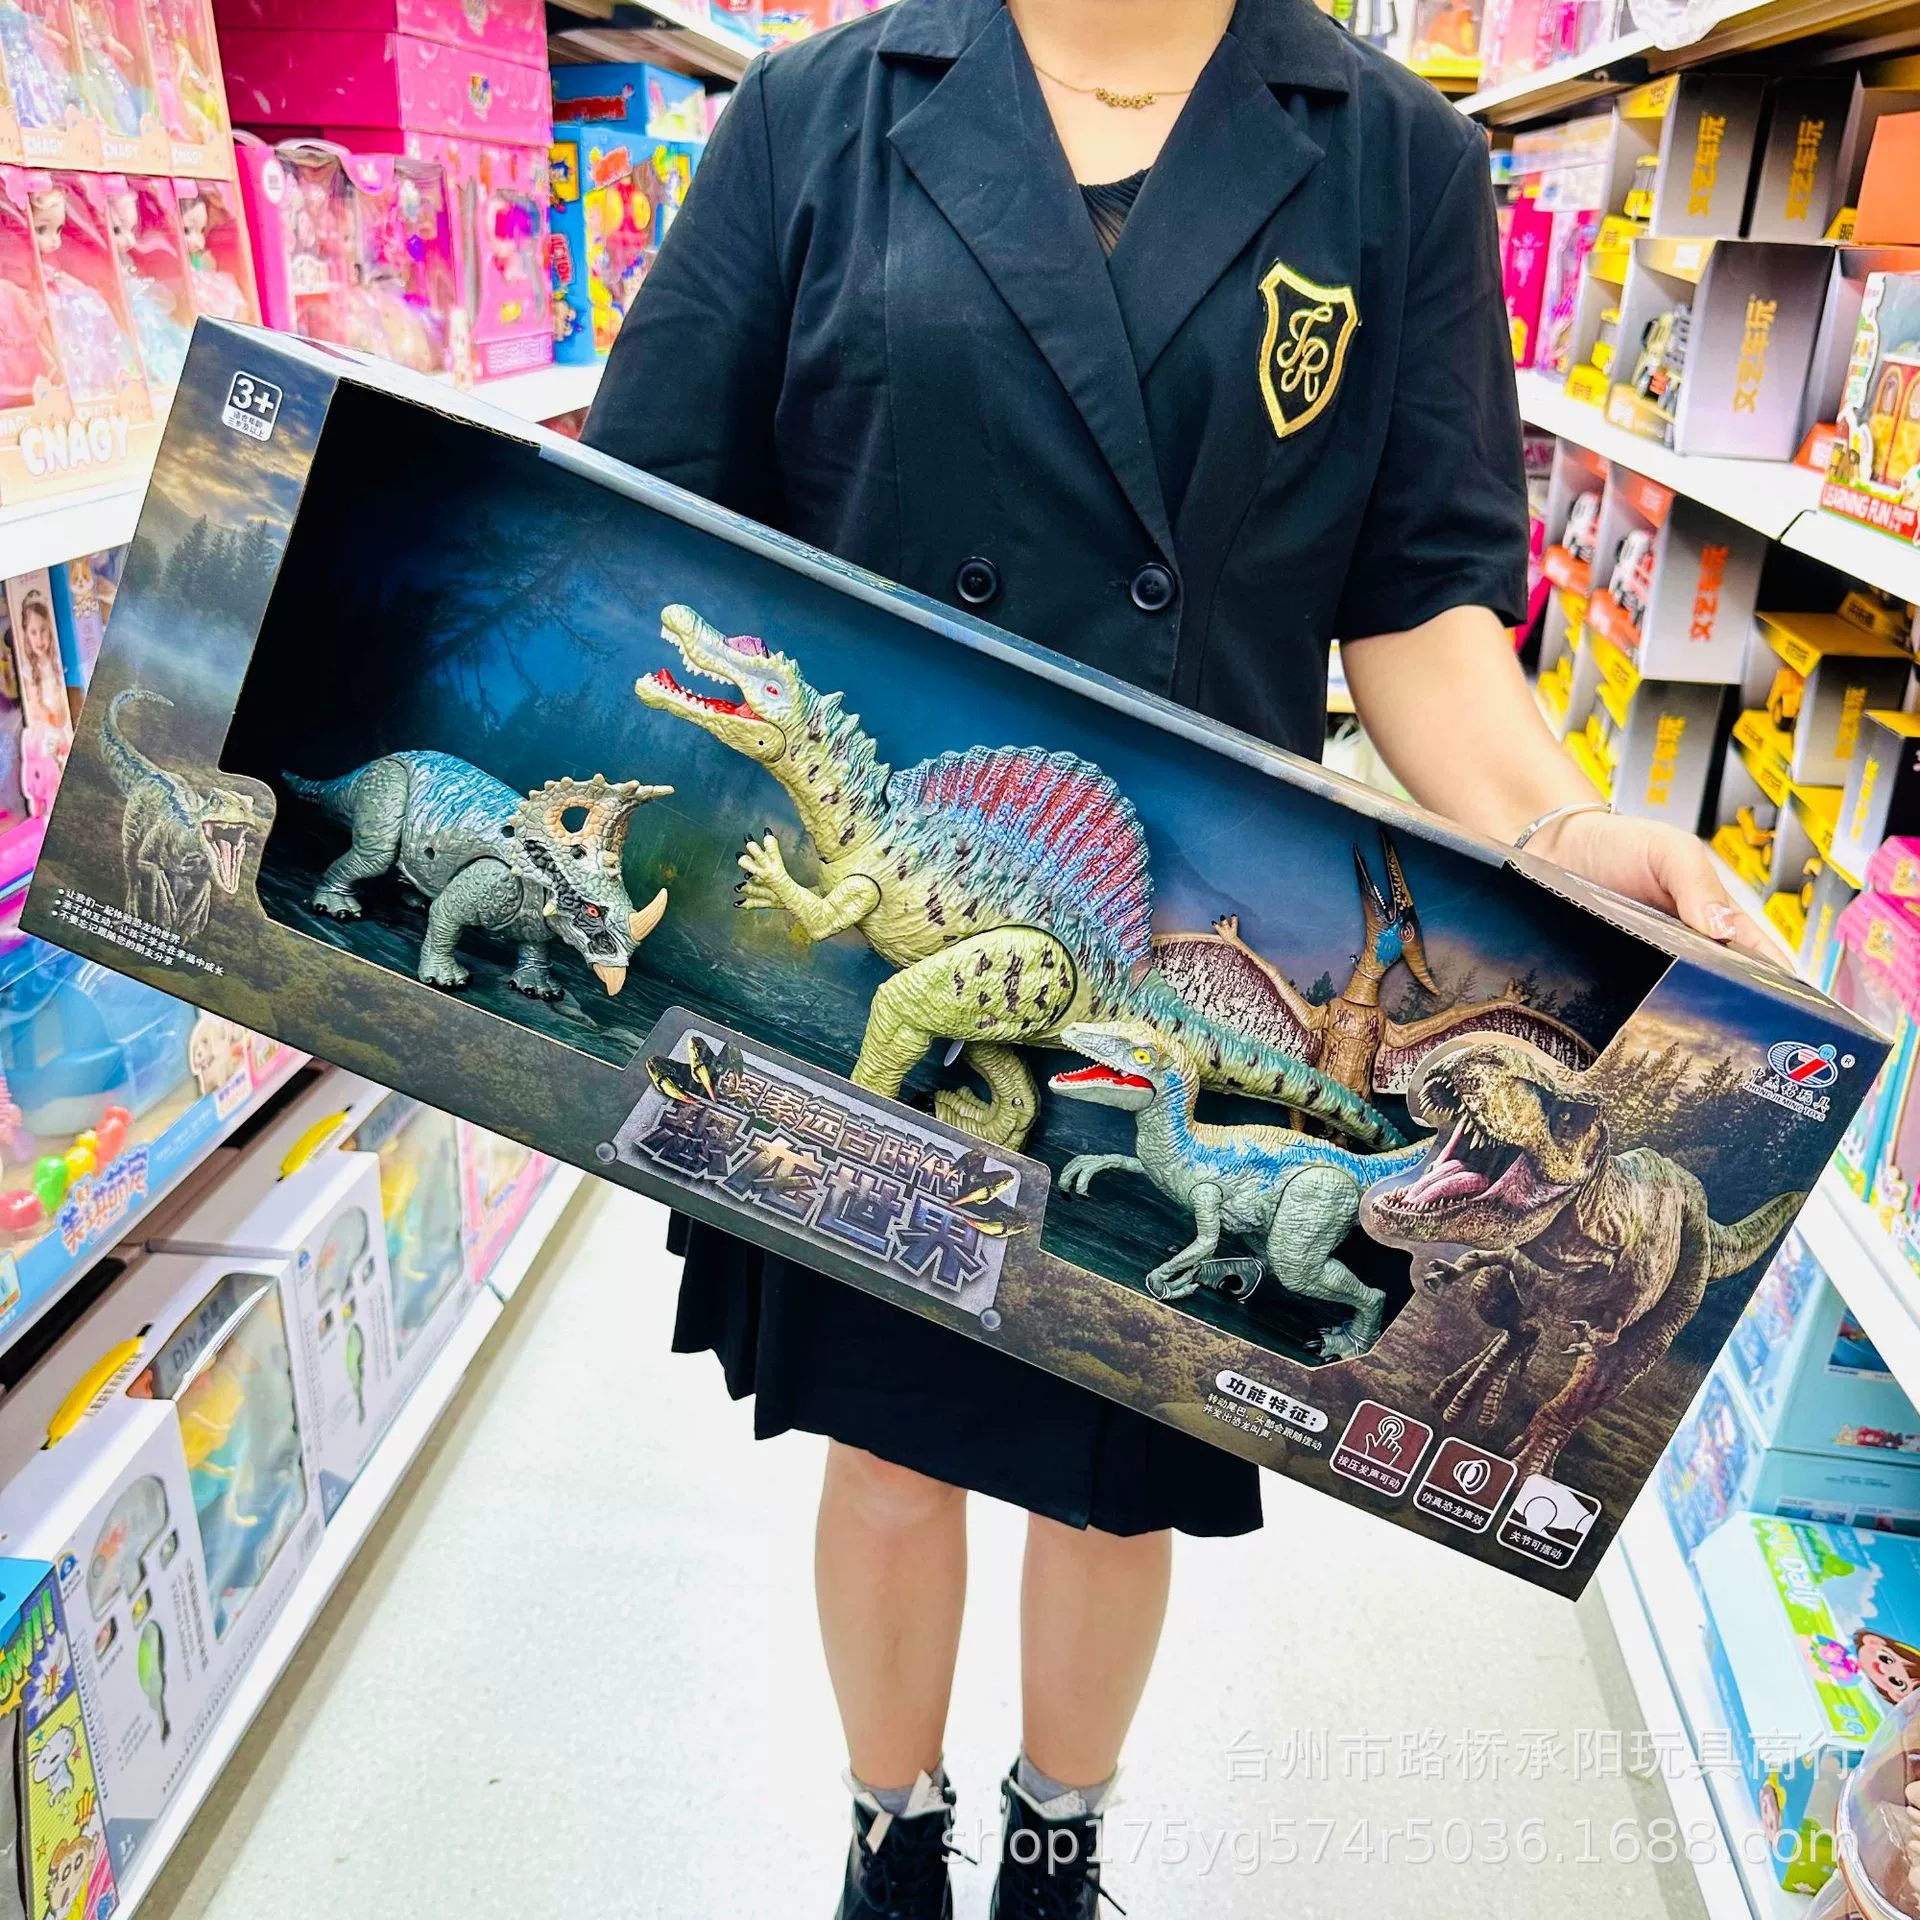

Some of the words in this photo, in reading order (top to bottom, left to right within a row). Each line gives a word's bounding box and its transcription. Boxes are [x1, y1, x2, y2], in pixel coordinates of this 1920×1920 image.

[232, 377, 275, 414] 3+
[20, 414, 129, 477] CNAGY
[1803, 1106, 1827, 1122] TOYS
[714, 1066, 968, 1201] 探索远古时代
[635, 1096, 988, 1290] 恐龙世界
[1336, 1454, 1401, 1491] 按压发声可动
[1420, 1491, 1485, 1527] 仿真恐龙声效
[1509, 1529, 1563, 1561] 关节可摆动
